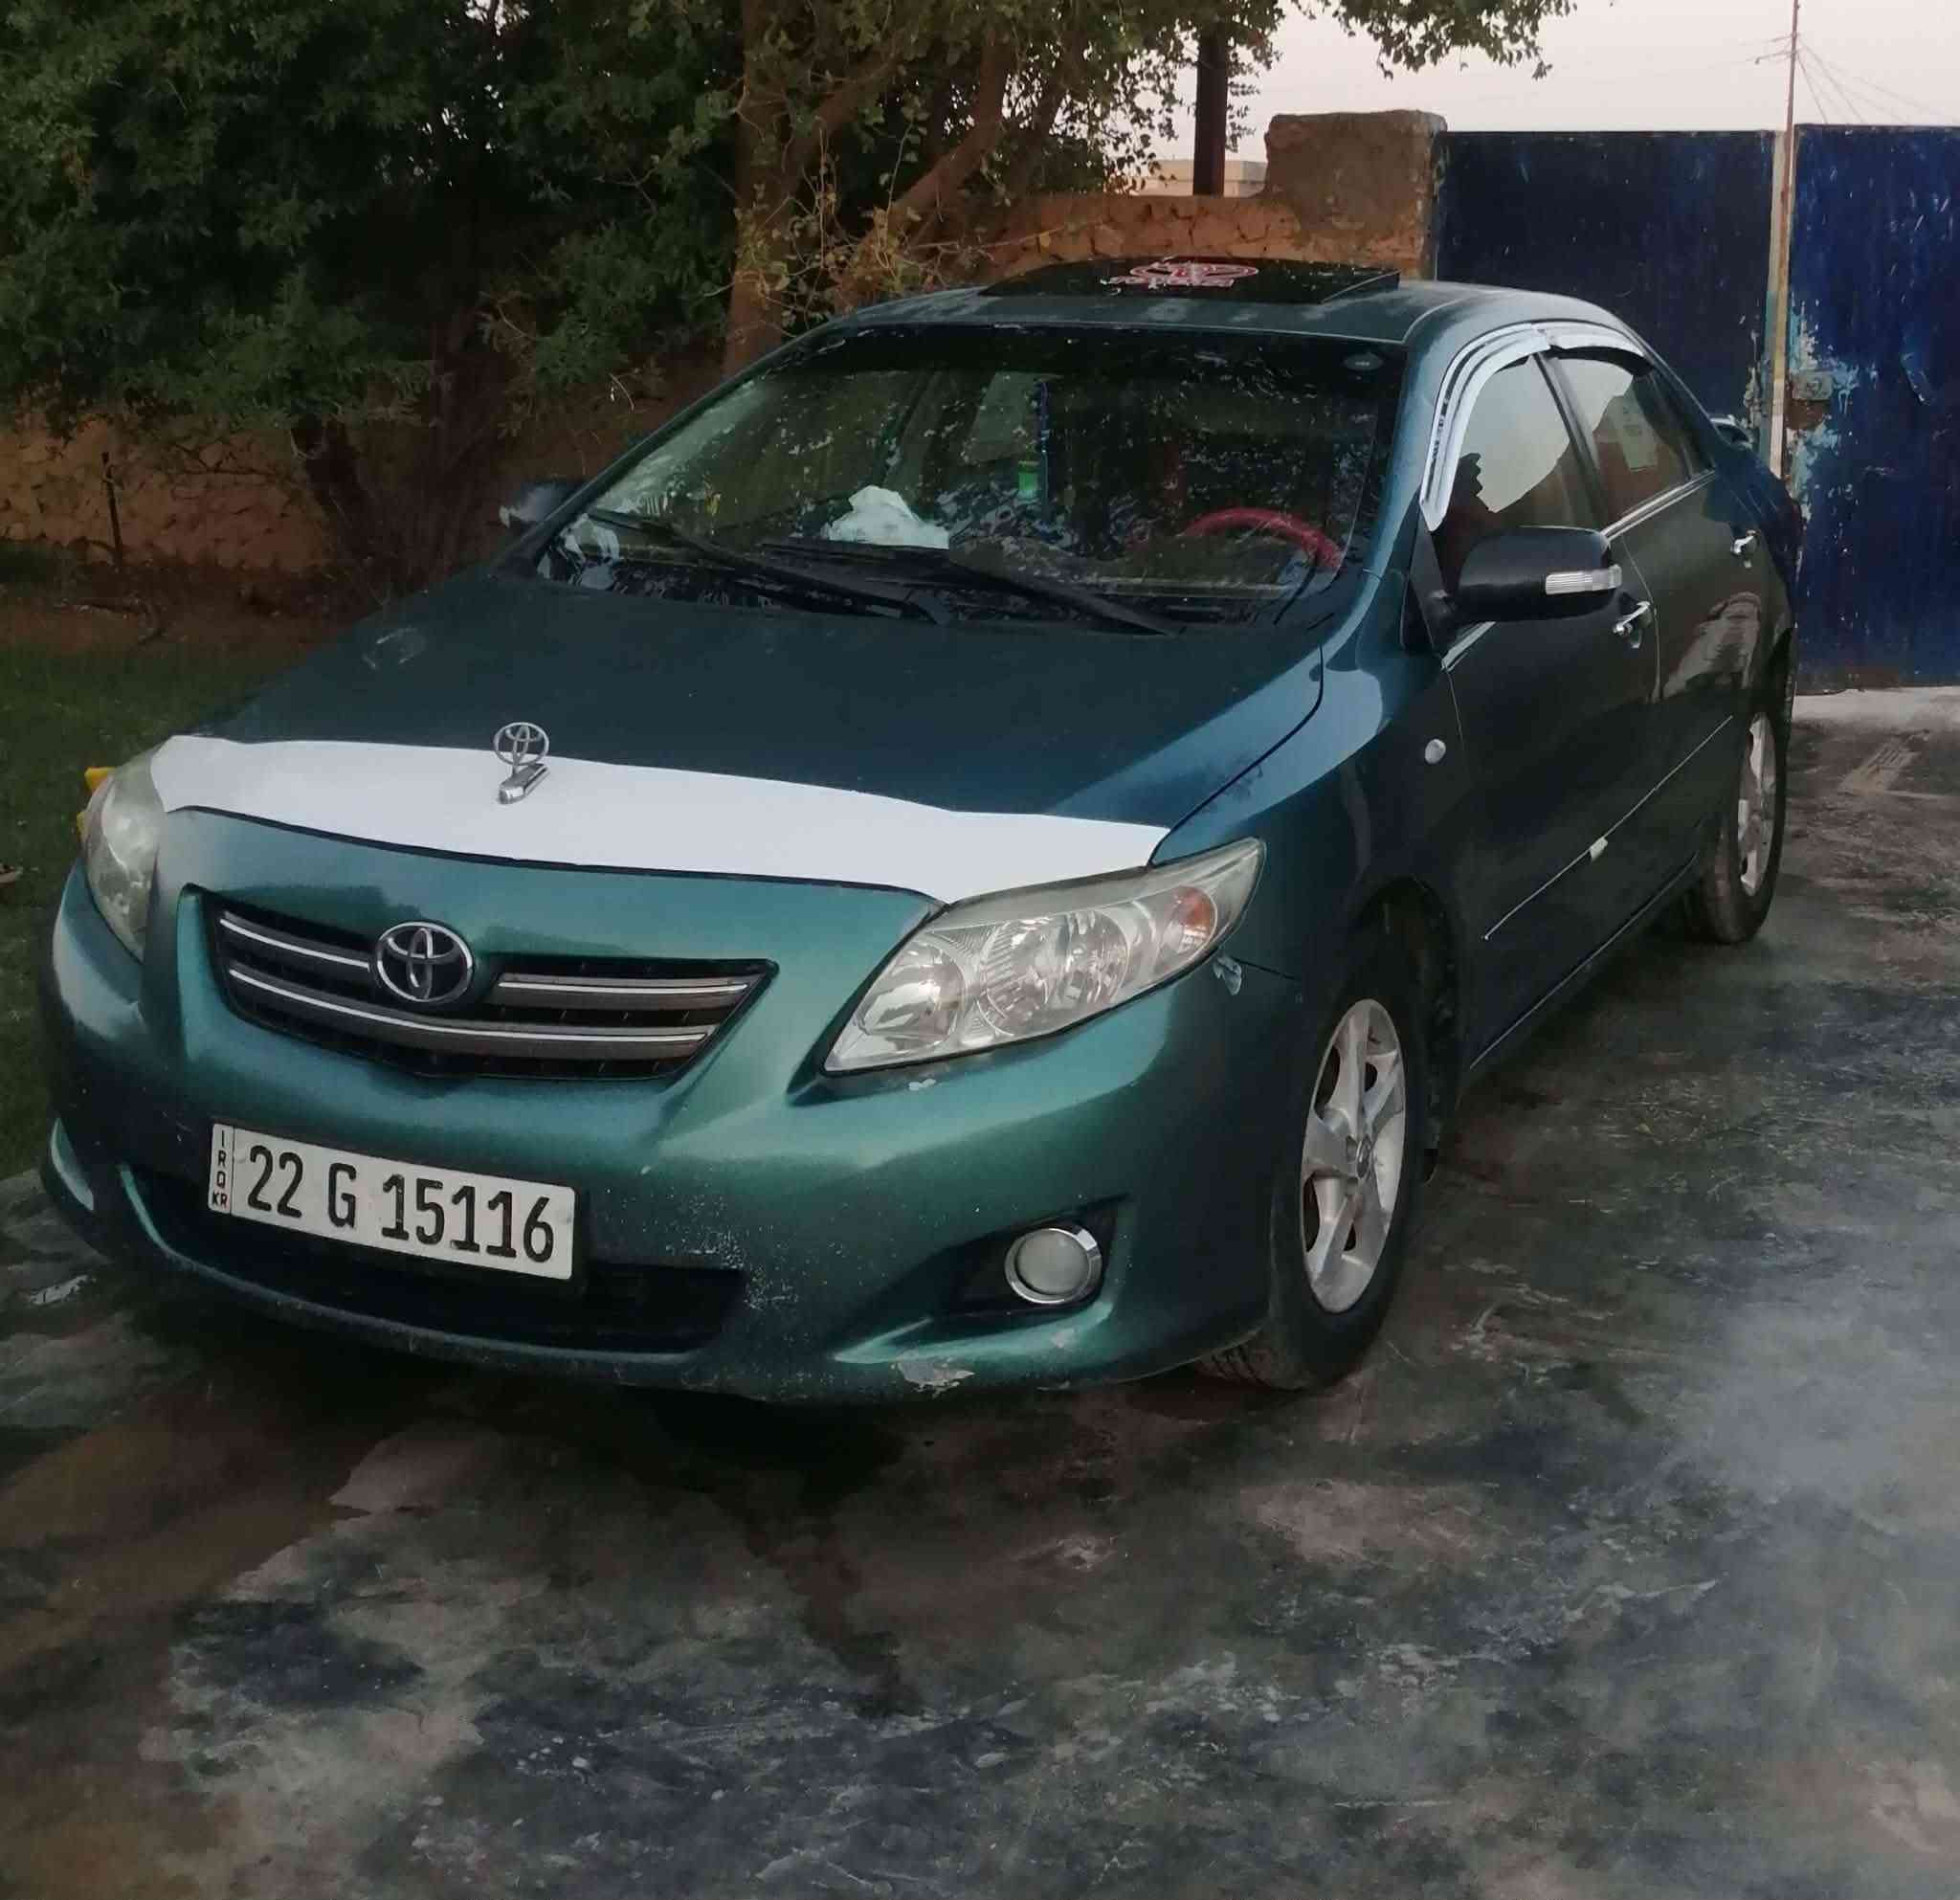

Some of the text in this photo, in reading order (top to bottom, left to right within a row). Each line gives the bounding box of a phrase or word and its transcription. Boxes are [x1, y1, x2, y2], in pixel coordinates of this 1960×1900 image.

[247, 1145, 555, 1263] 22 G 15116
